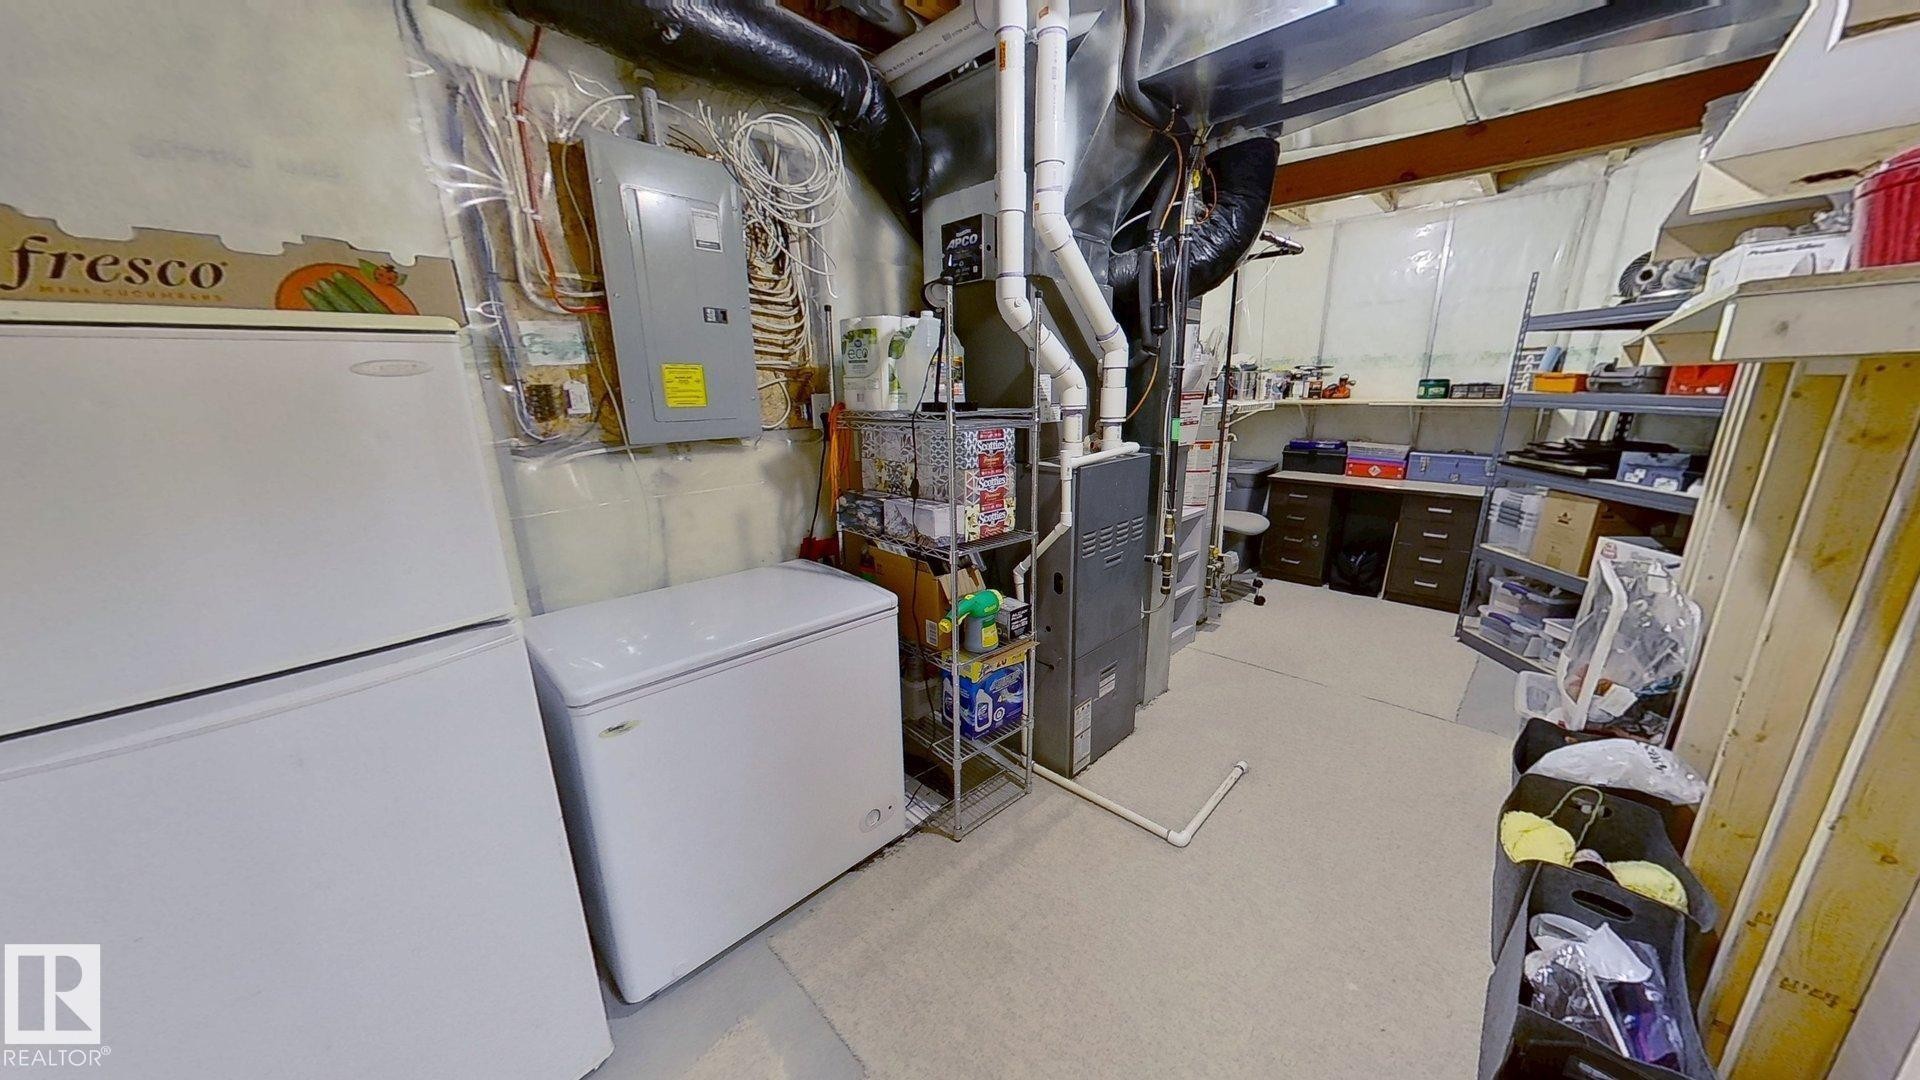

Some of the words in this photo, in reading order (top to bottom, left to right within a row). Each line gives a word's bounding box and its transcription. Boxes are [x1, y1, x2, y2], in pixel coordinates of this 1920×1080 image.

[946, 233, 978, 250] APCO
[0, 236, 224, 290] fresco
[847, 347, 869, 360] eco
[978, 440, 1006, 452] Scotties
[979, 476, 1007, 489] Scotties
[979, 510, 1007, 523] Scotties
